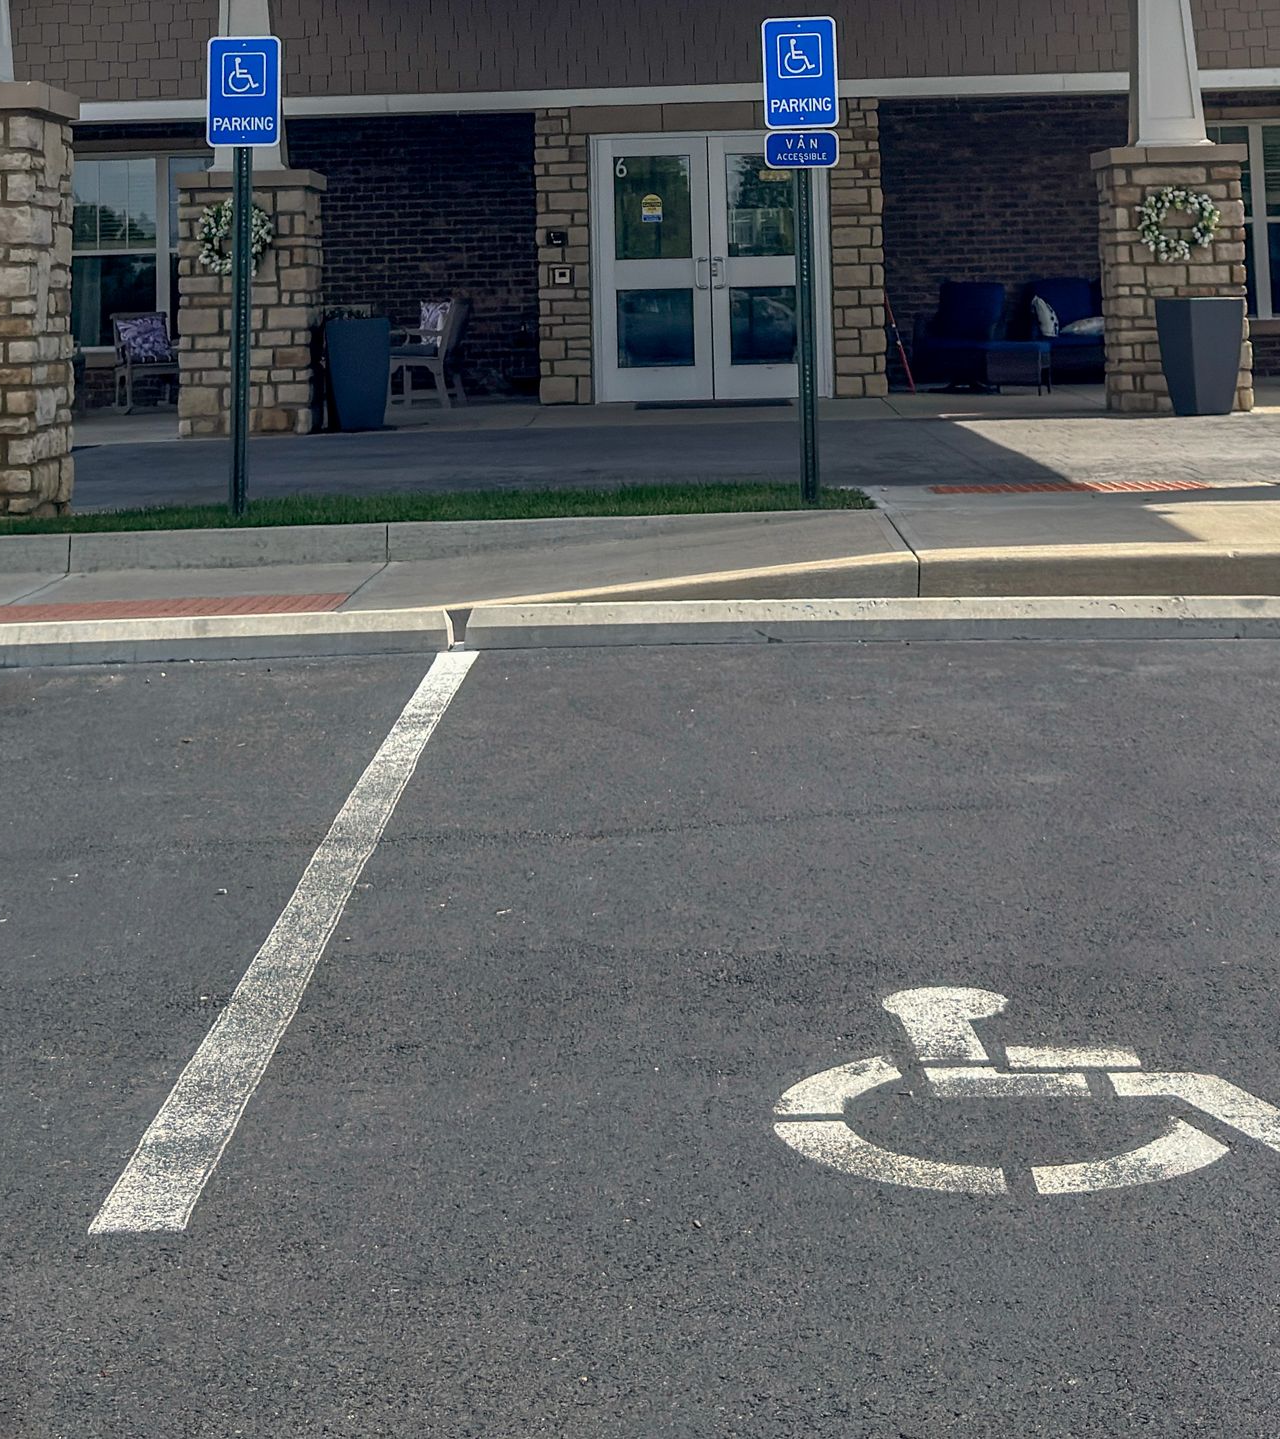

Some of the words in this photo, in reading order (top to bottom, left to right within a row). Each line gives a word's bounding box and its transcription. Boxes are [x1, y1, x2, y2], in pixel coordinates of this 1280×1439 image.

[771, 97, 832, 113] PARKING
[213, 117, 274, 131] PARKING
[785, 138, 818, 149] VAN
[776, 152, 827, 161] ACCESSIBLE
[616, 158, 627, 178] 6
